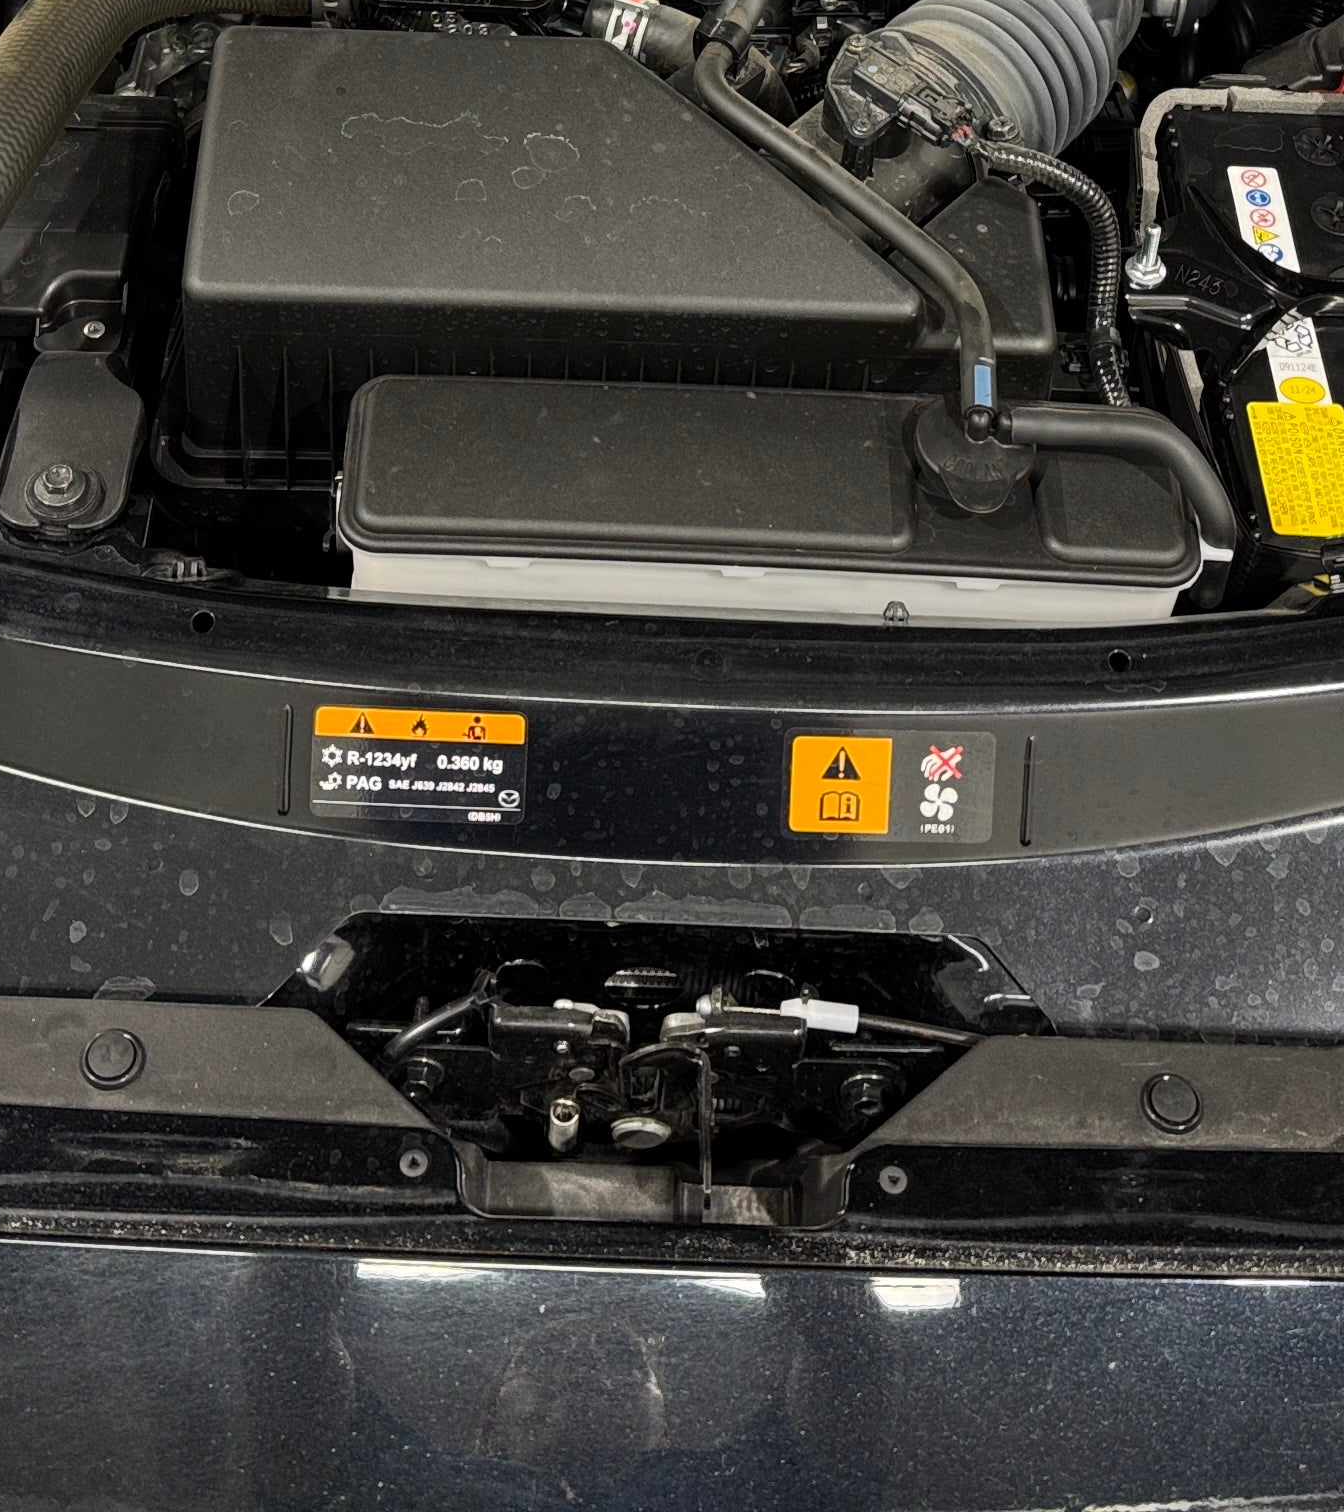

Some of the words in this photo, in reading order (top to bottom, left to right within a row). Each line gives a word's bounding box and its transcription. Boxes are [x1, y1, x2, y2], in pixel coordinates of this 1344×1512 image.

[1279, 361, 1317, 373] 091124E
[1289, 384, 1316, 395] 11/24
[1288, 422, 1302, 454] POISON
[347, 750, 418, 770] R-1234yf
[437, 754, 480, 770] 0.360
[483, 756, 504, 775] kg
[346, 775, 382, 792] PAG
